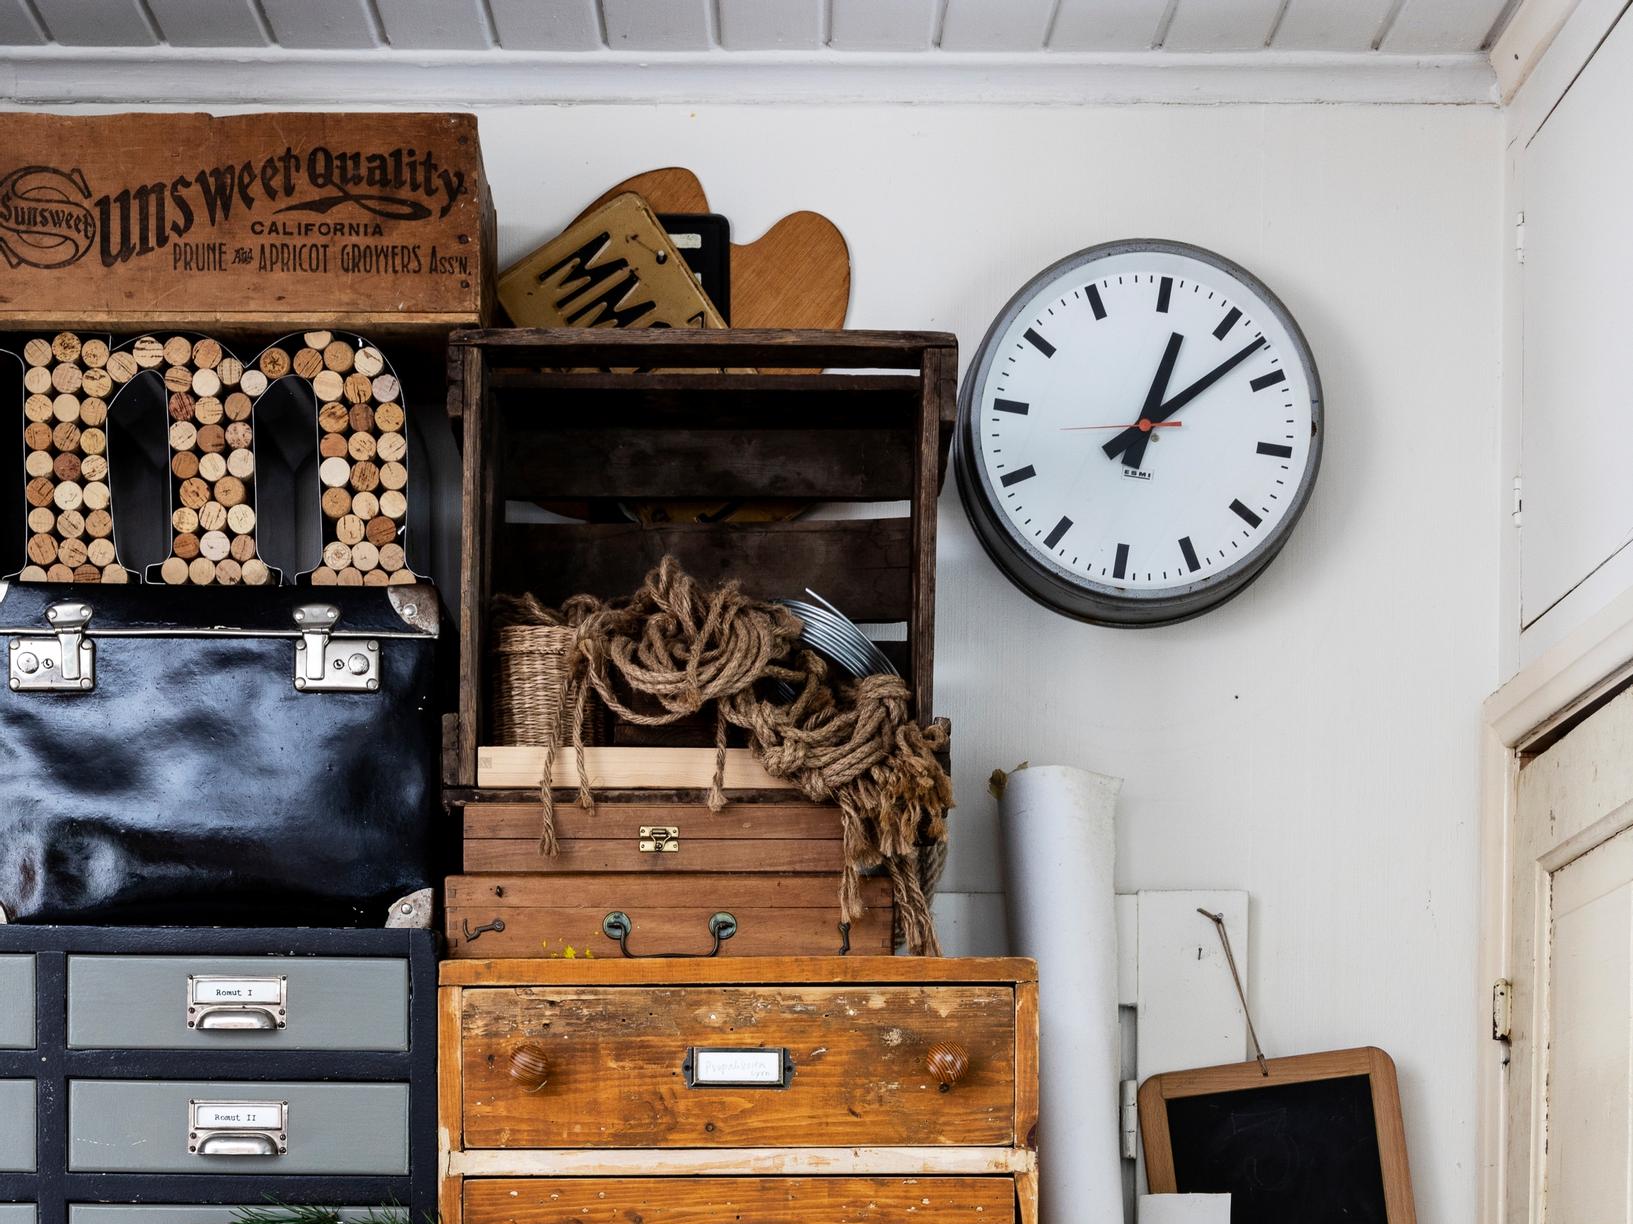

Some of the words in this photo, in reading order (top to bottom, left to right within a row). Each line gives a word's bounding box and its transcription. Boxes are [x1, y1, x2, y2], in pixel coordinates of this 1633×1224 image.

[307, 147, 468, 220] Quality
[0, 190, 92, 240] Sunsweet
[251, 220, 384, 236] CALIFORNIA
[173, 242, 227, 272] PRUNE
[258, 243, 330, 273] APRICOT
[340, 243, 422, 273] GROWERS
[1124, 469, 1151, 478] ESMI
[216, 989, 241, 997] Romut
[214, 1113, 240, 1122] Romut
